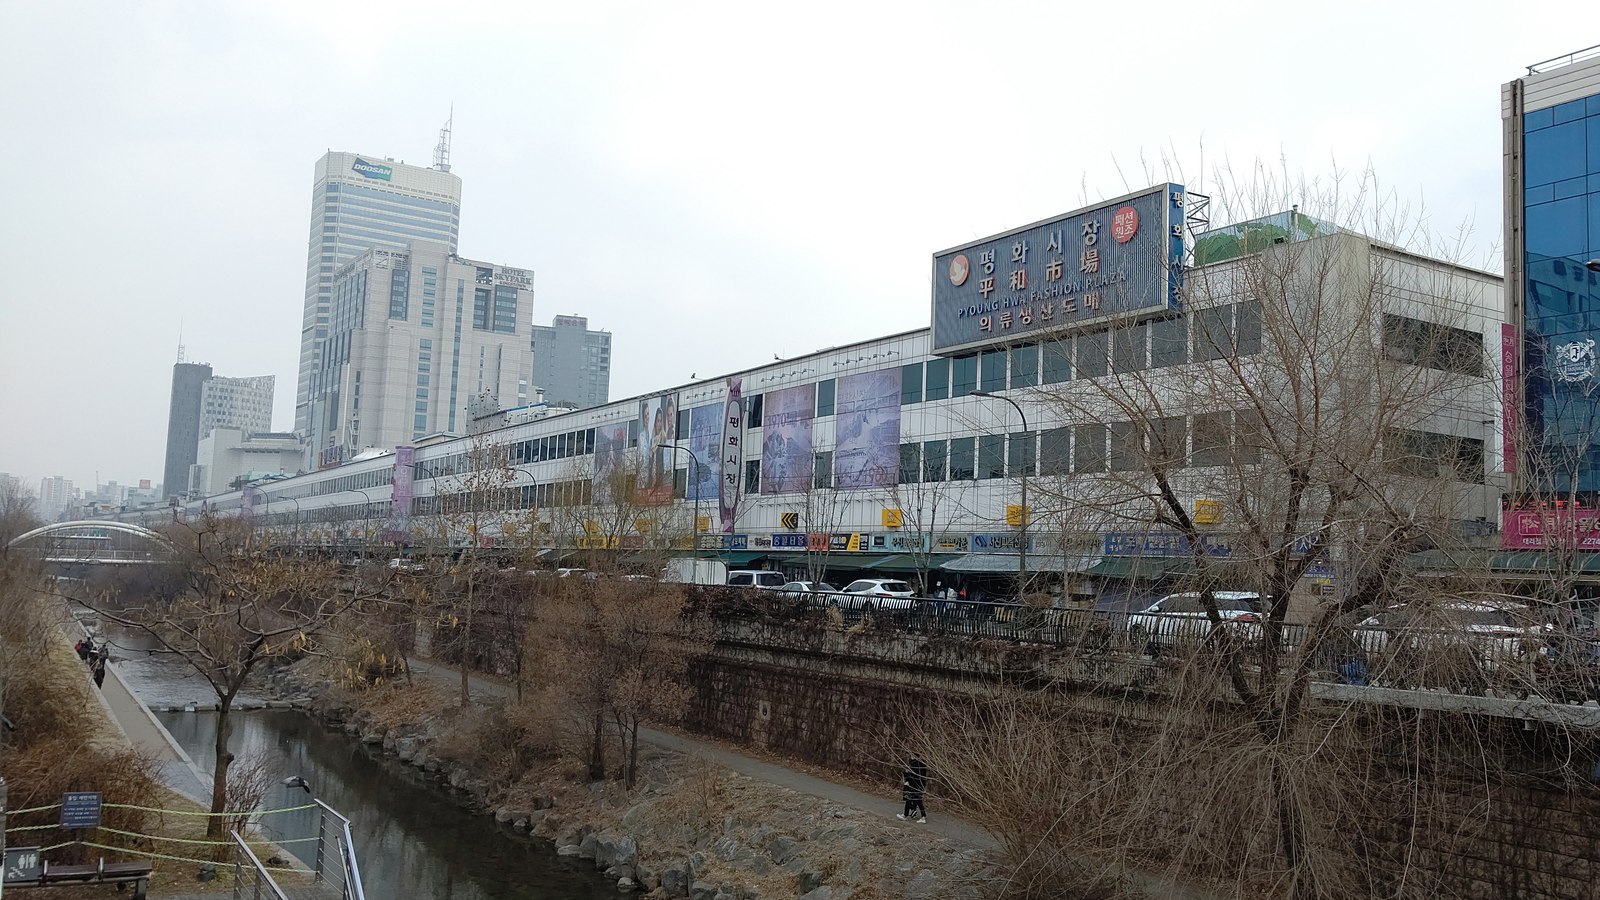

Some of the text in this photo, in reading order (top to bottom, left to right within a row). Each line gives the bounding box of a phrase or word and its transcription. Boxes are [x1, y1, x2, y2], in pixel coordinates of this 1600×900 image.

[354, 163, 391, 175] DOOSAN
[979, 220, 1101, 275] 평화시장
[494, 273, 532, 285] SKYPARK
[501, 267, 526, 277] HOTEL
[957, 272, 1126, 318] PYOUNG HWA FASHION PLAZA
[979, 248, 1099, 299] 平和市場
[725, 416, 739, 485] 평화시장
